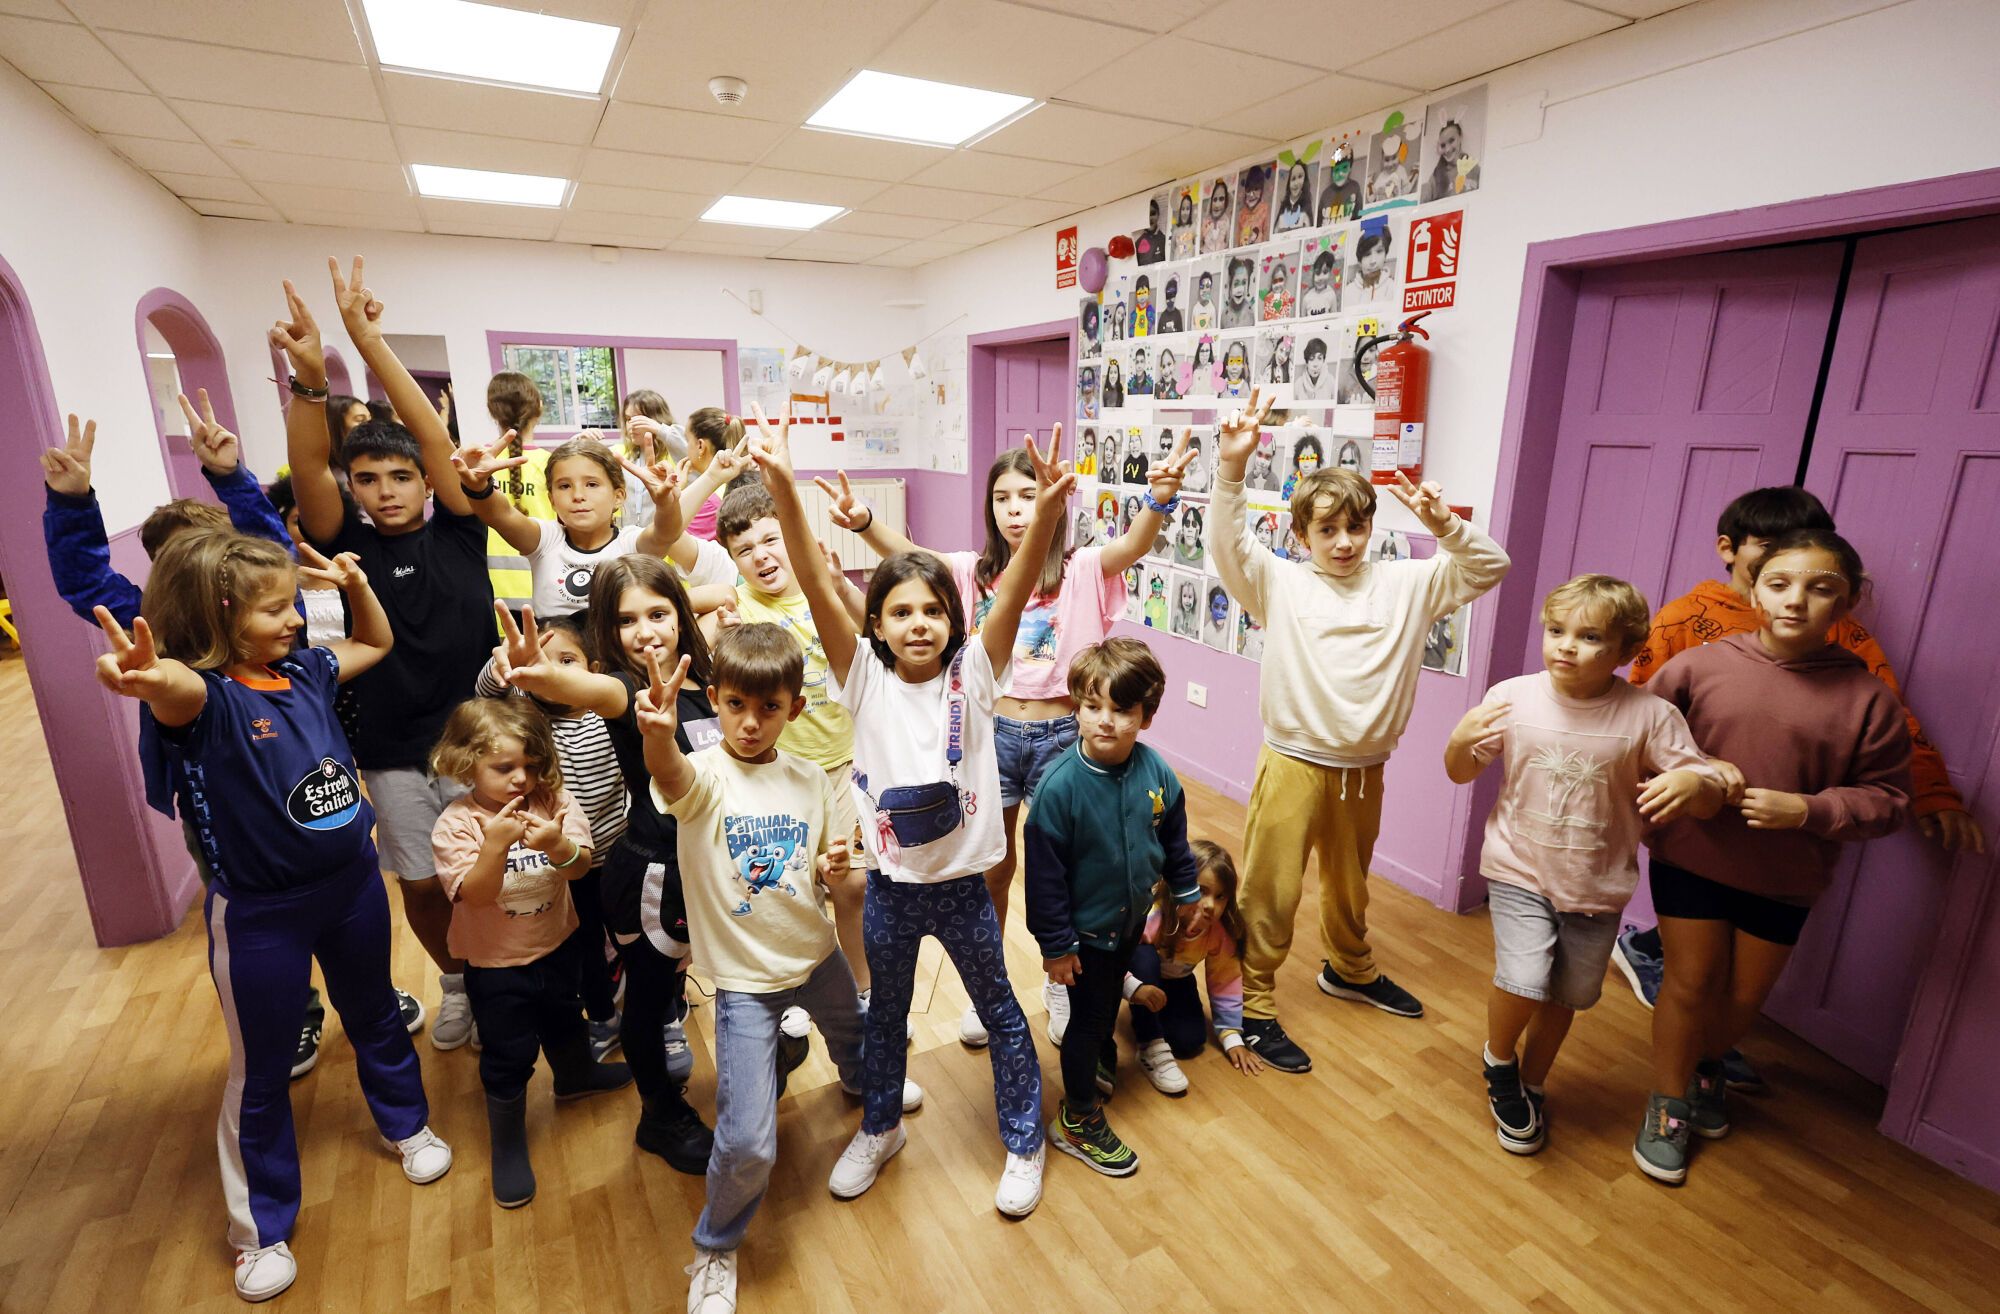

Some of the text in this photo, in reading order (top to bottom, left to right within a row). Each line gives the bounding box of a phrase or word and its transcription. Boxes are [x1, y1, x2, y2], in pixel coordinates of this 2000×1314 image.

[1405, 286, 1453, 309] EXTINTOR
[577, 573, 586, 584] 3
[951, 646, 966, 678] TREN
[309, 788, 354, 817] Galicia
[744, 814, 791, 834] ITALIAN
[726, 821, 810, 860] BRAINROT
